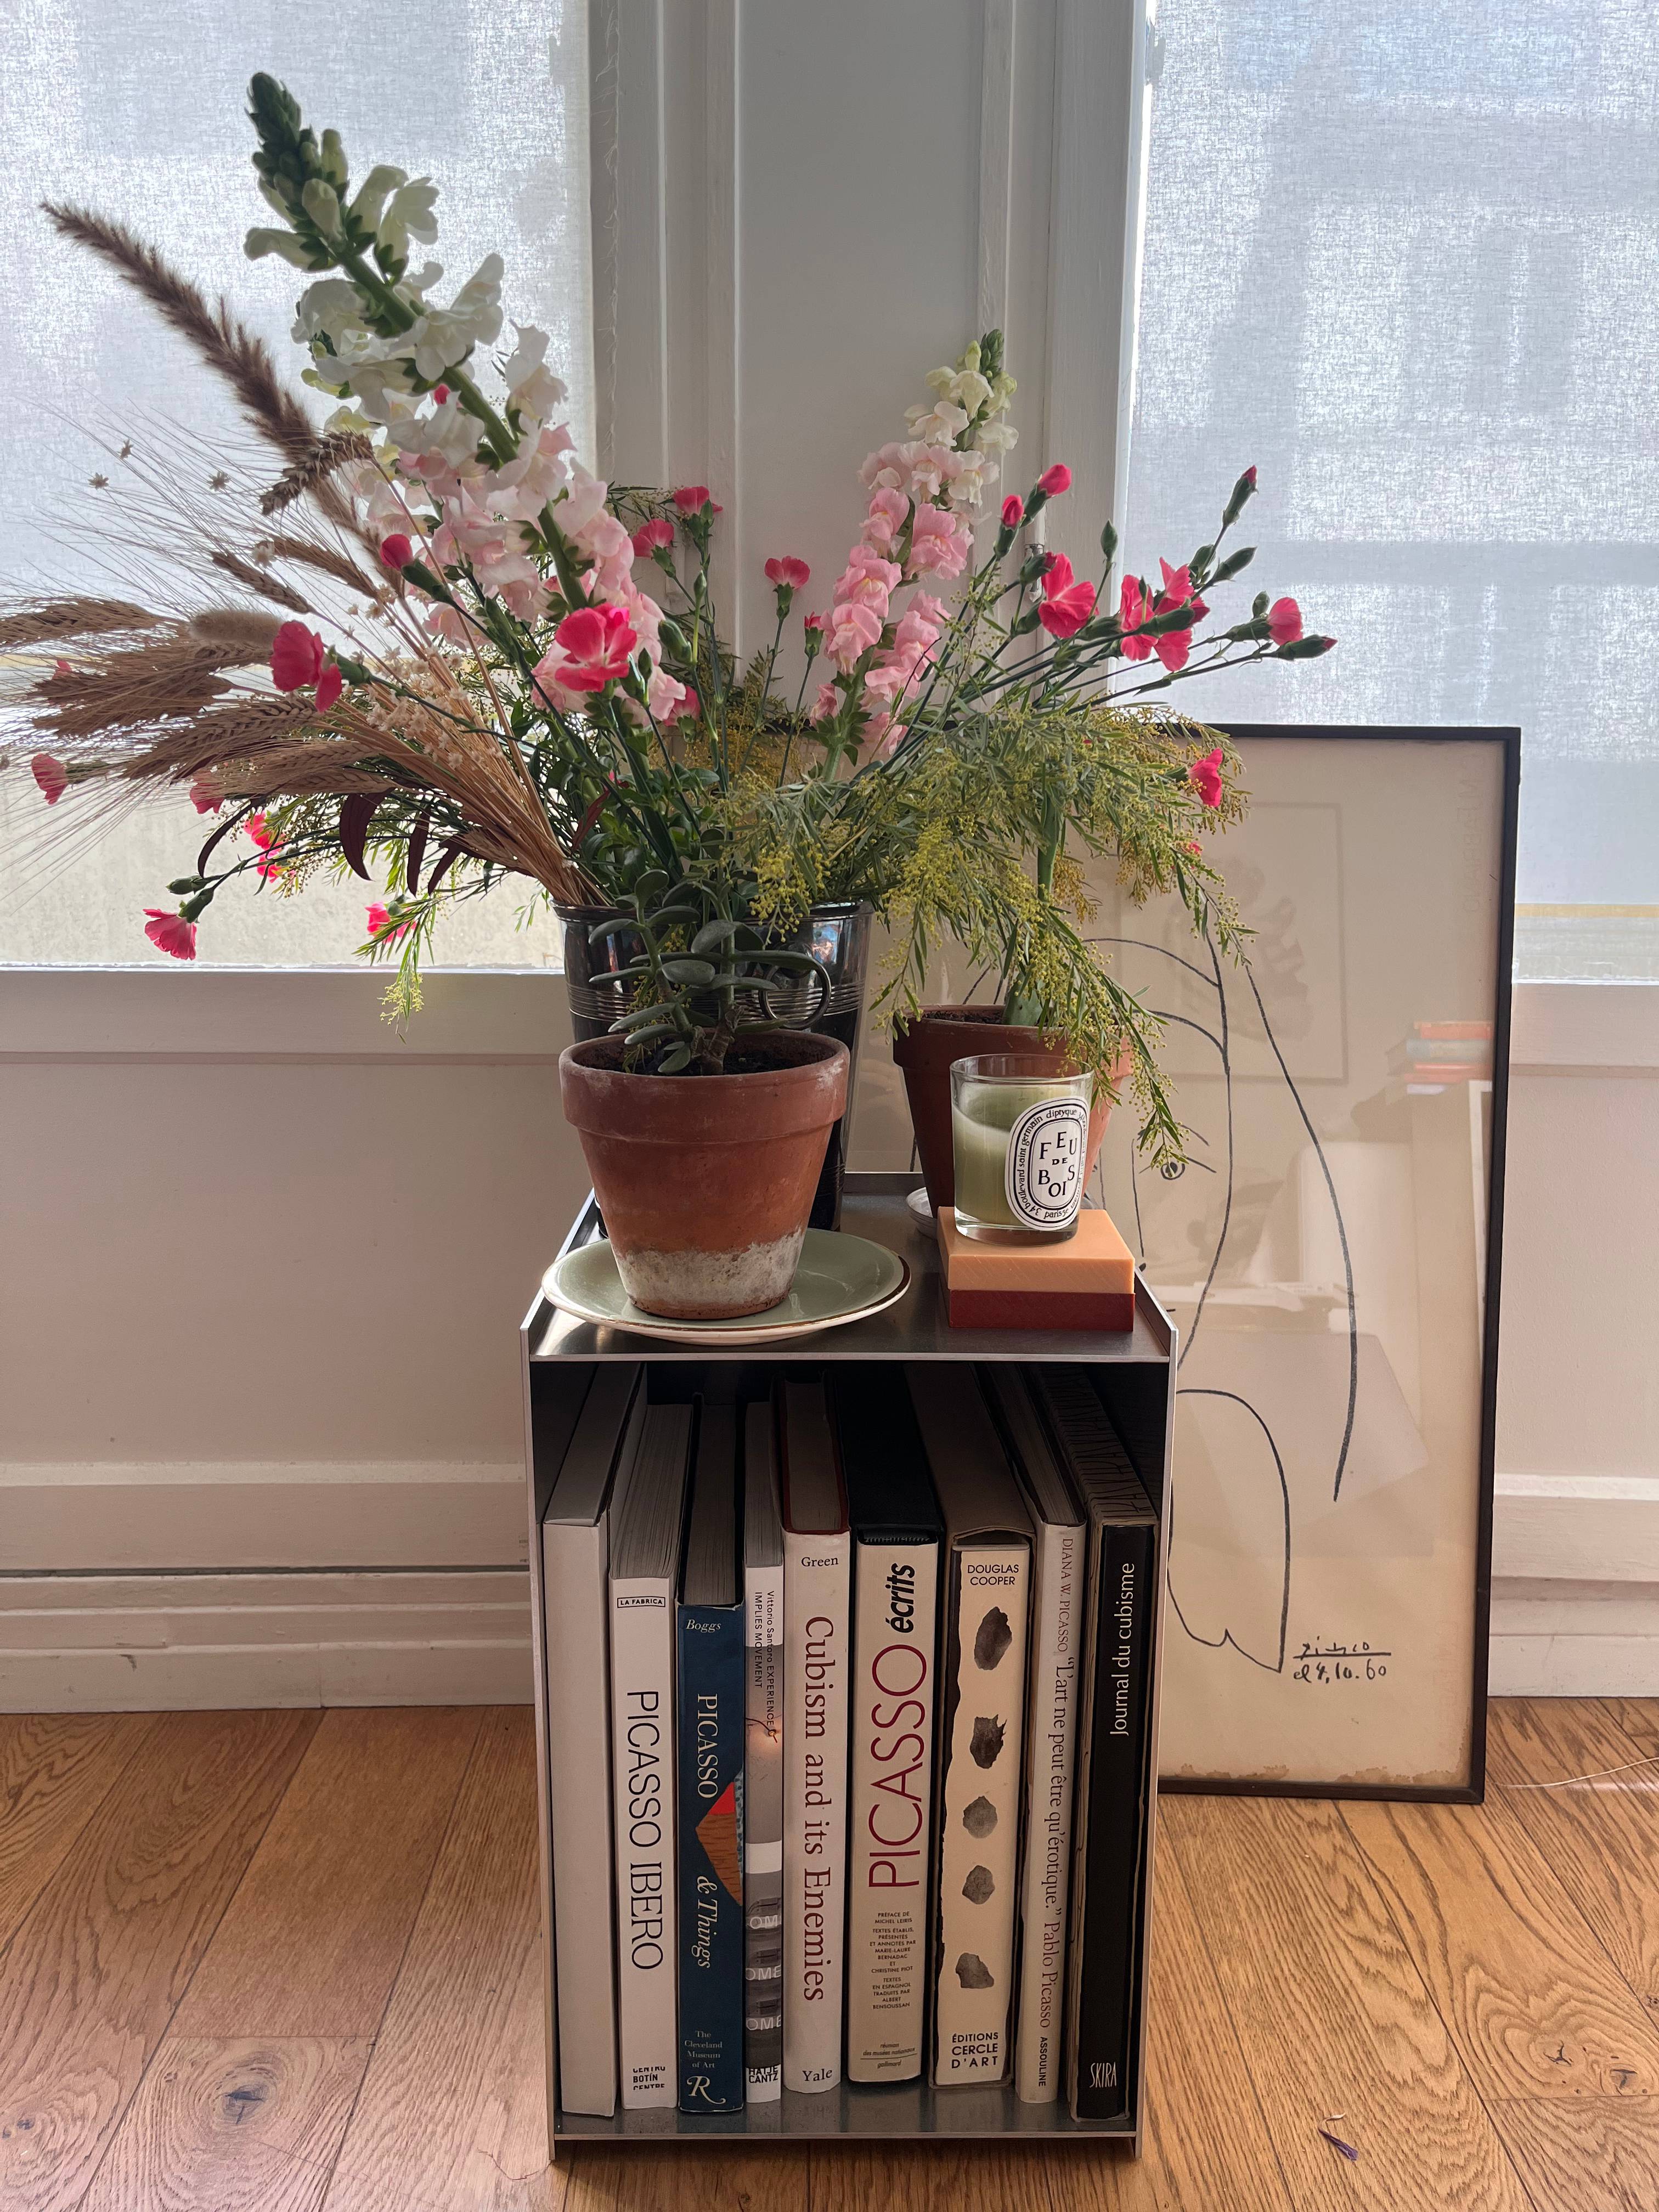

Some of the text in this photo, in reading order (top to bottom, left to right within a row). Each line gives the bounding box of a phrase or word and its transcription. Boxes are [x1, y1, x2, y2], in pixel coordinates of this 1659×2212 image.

[1046, 1109, 1077, 1119] diptyque
[1022, 1116, 1043, 1146] germain
[1039, 1131, 1077, 1159] FEU
[1018, 1148, 1026, 1167] saint
[1052, 1157, 1068, 1165] DE
[1017, 1169, 1031, 1209] boulevard
[1038, 1164, 1075, 1198] BOIS
[801, 1557, 838, 1567] Green
[967, 1564, 1019, 1573] DOUGLAS
[970, 1576, 1015, 1585] COOPER
[1057, 1538, 1073, 1652] DIANA W. PICASSO
[686, 1619, 721, 1633] Boggs
[754, 1592, 763, 1688] IMPLIES MOVEMENT
[1110, 1563, 1135, 1736] Journal du cubisme
[868, 1563, 927, 1887] PICASSO écrits
[1053, 1707, 1065, 1729] ne
[697, 1693, 718, 1798] PICASSO
[1048, 1733, 1065, 1771] peut
[1049, 1775, 1067, 1807] être
[804, 1616, 836, 2001] Cubism and its Enemies
[627, 1691, 663, 1970] PICASSO IBERO
[691, 1876, 718, 1968] & Things
[1040, 1921, 1060, 2028] Pablo Picasso
[684, 2040, 723, 2048] Cleveland
[951, 2043, 998, 2055] CERCLE
[952, 2032, 998, 2043] ÉDITIONS
[802, 2068, 832, 2081] Yale
[951, 2056, 998, 2069] D'ART
[1039, 2036, 1048, 2087] ASSOULINE
[1088, 2062, 1117, 2088] SKIRA
[633, 2073, 658, 2083] BOTÍN
[687, 2075, 726, 2104] R
[749, 2073, 778, 2083] CANTZ
